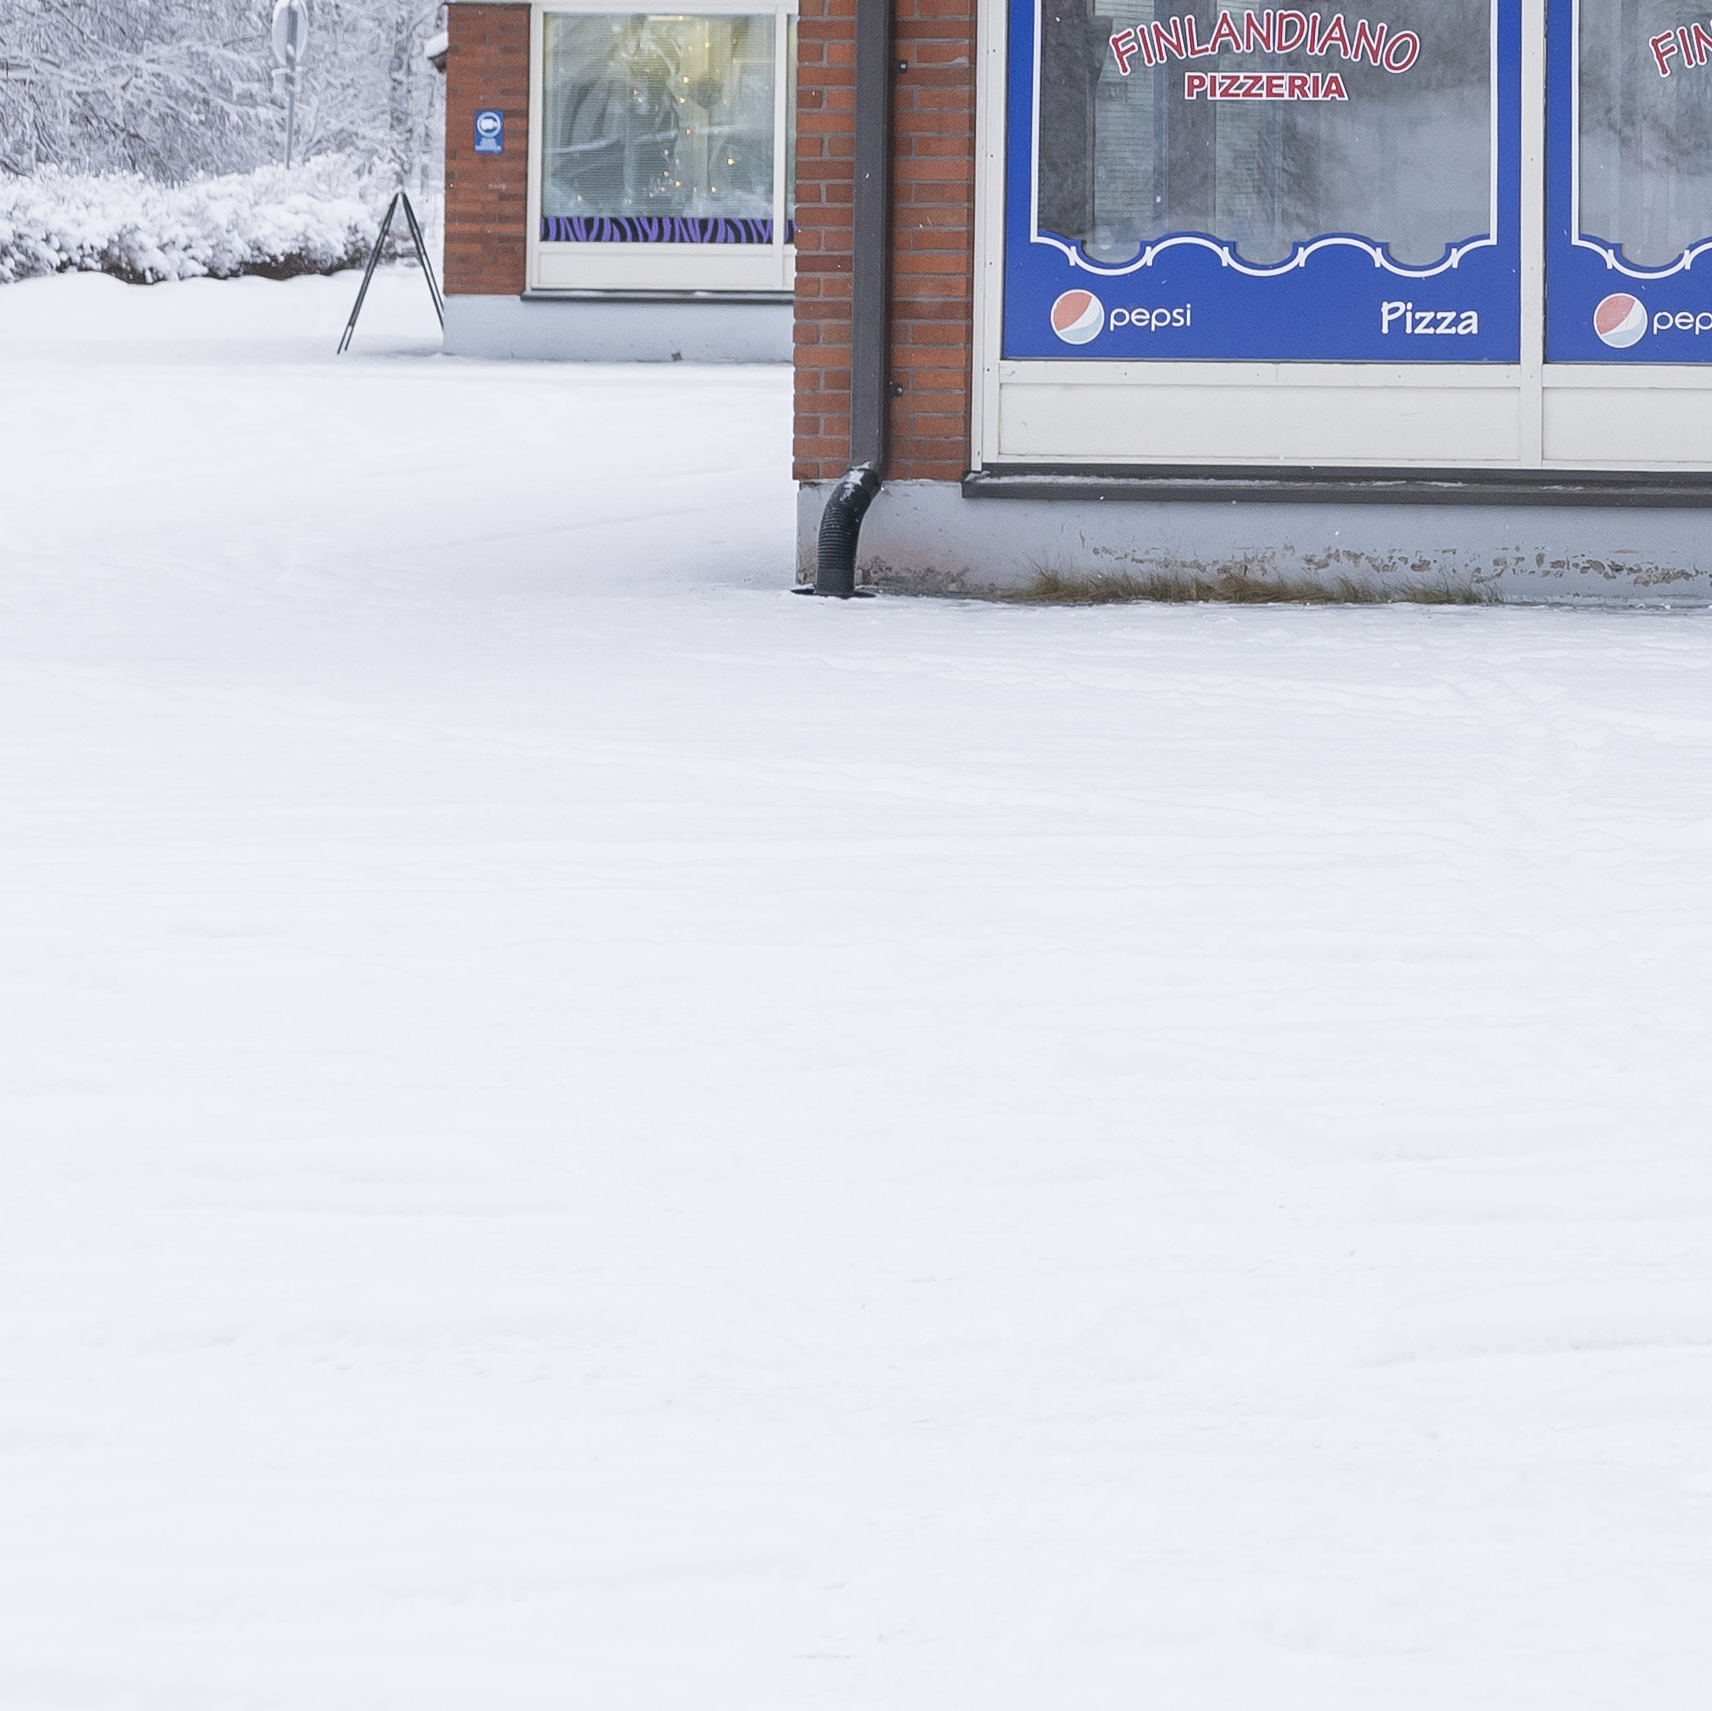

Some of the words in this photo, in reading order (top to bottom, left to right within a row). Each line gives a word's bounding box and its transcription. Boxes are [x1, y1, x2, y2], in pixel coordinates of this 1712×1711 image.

[1110, 10, 1420, 76] FINLANDIANO
[1185, 73, 1348, 101] PIZZERIA
[1109, 302, 1192, 332] pepsi
[1381, 301, 1479, 336] Pizza
